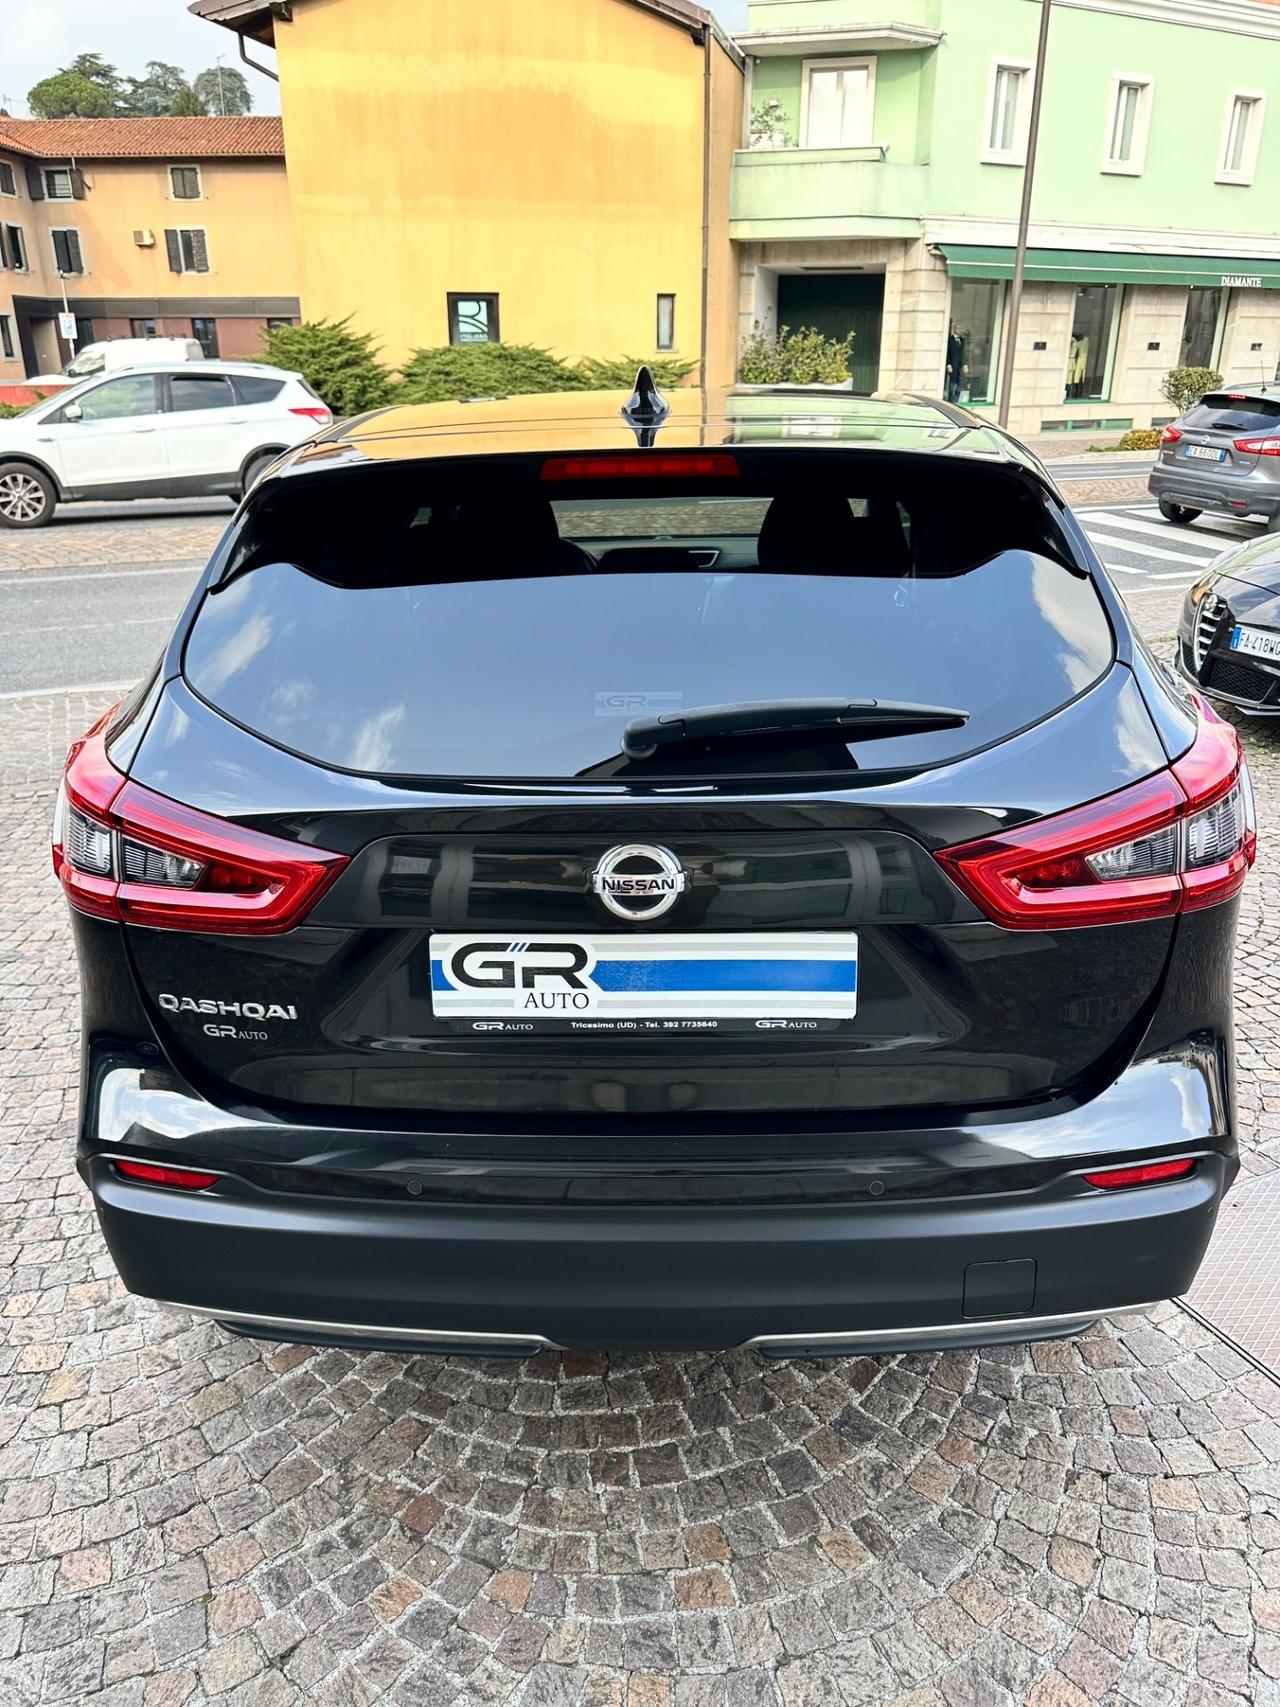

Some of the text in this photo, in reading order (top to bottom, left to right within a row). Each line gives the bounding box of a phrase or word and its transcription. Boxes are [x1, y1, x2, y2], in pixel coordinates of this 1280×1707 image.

[1221, 277, 1262, 287] DIAMANTE
[606, 695, 647, 707] GR
[602, 878, 675, 892] NISSAN
[451, 942, 590, 989] GR
[158, 993, 298, 1021] QASHQAI
[523, 991, 590, 1009] AUTO
[571, 1021, 614, 1029] Tricesimo
[616, 1021, 637, 1029] (UD)
